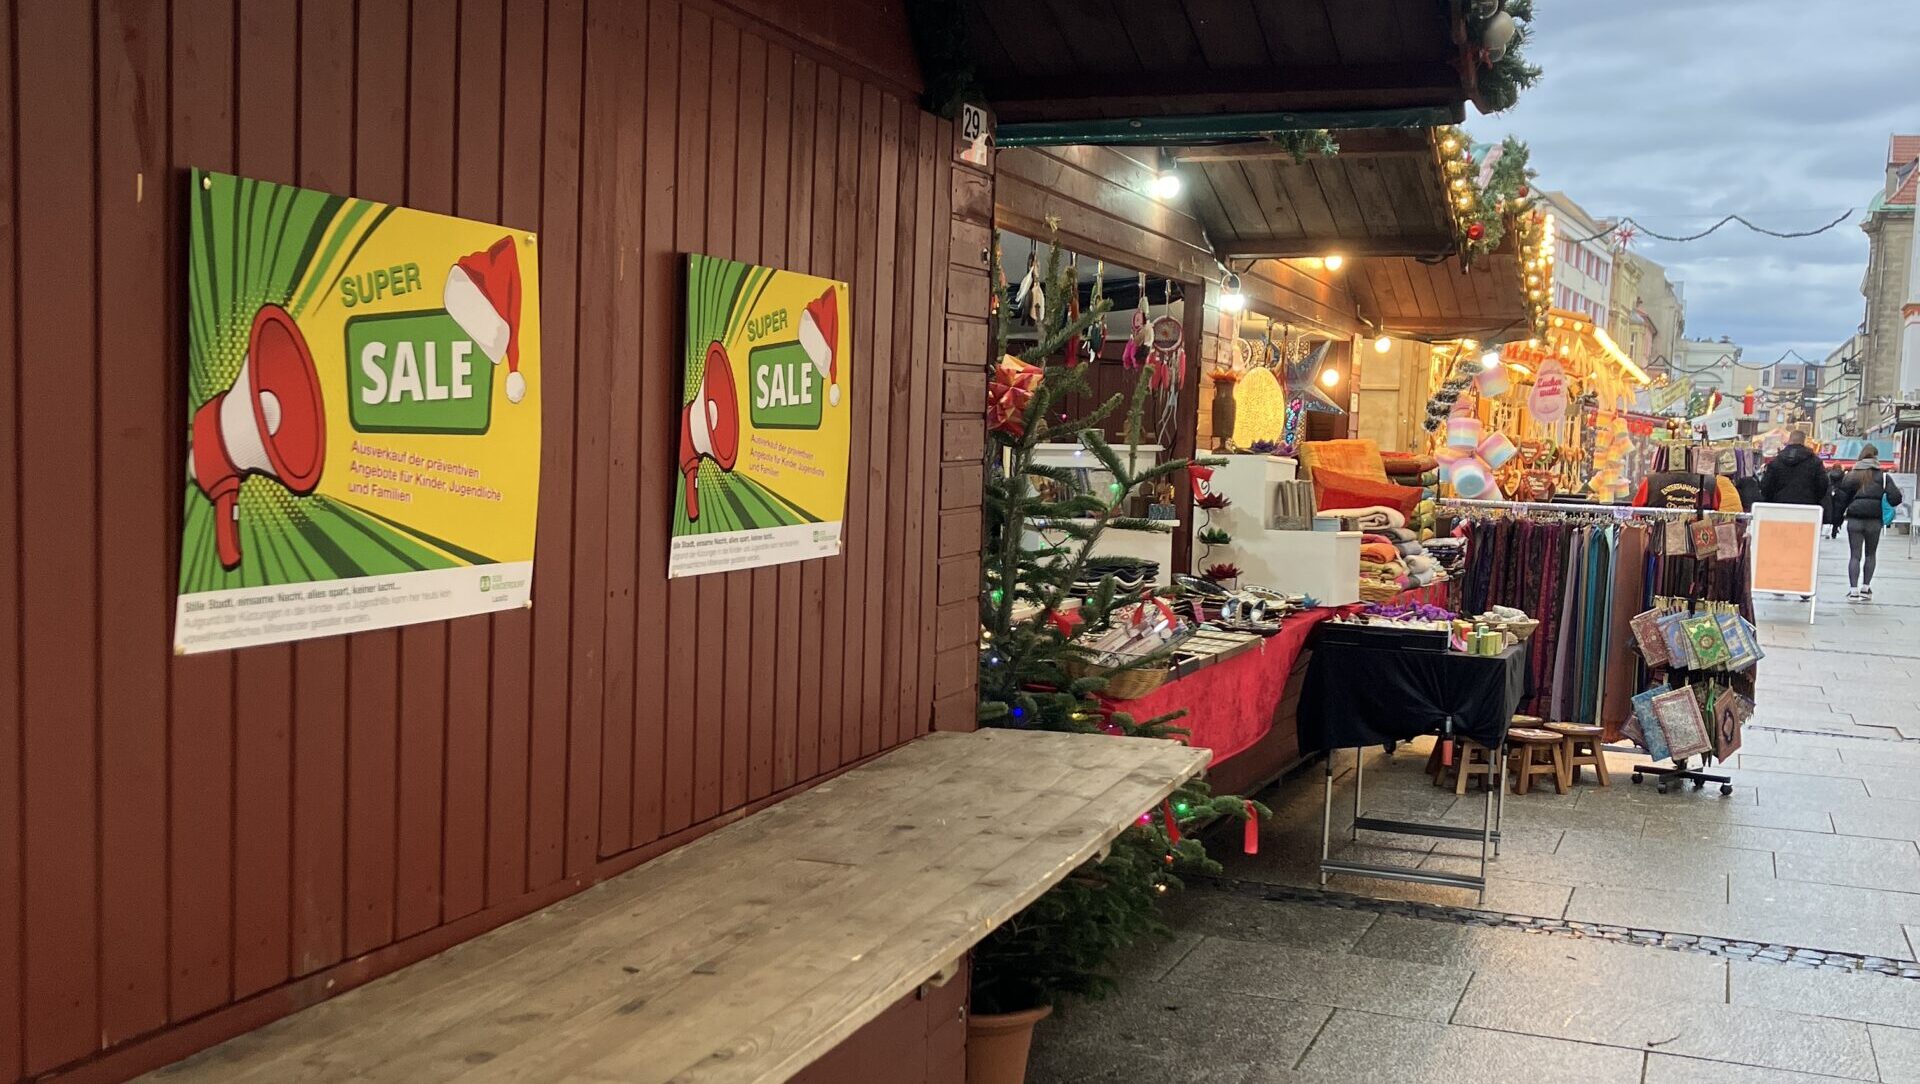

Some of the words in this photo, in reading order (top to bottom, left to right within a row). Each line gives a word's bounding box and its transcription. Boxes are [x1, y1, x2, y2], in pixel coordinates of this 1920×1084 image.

[964, 107, 980, 139] 29
[340, 262, 422, 307] SUPER
[747, 308, 787, 342] SUPER
[361, 340, 473, 404] SALE
[756, 362, 812, 409] SALE
[351, 440, 407, 462] Ausverkauf
[408, 453, 425, 466] der
[426, 459, 480, 479] präventiven
[348, 482, 369, 495] und
[371, 484, 411, 502] Familien
[351, 460, 398, 480] Angebote
[399, 470, 414, 483] für
[449, 481, 502, 501] Jugendliche
